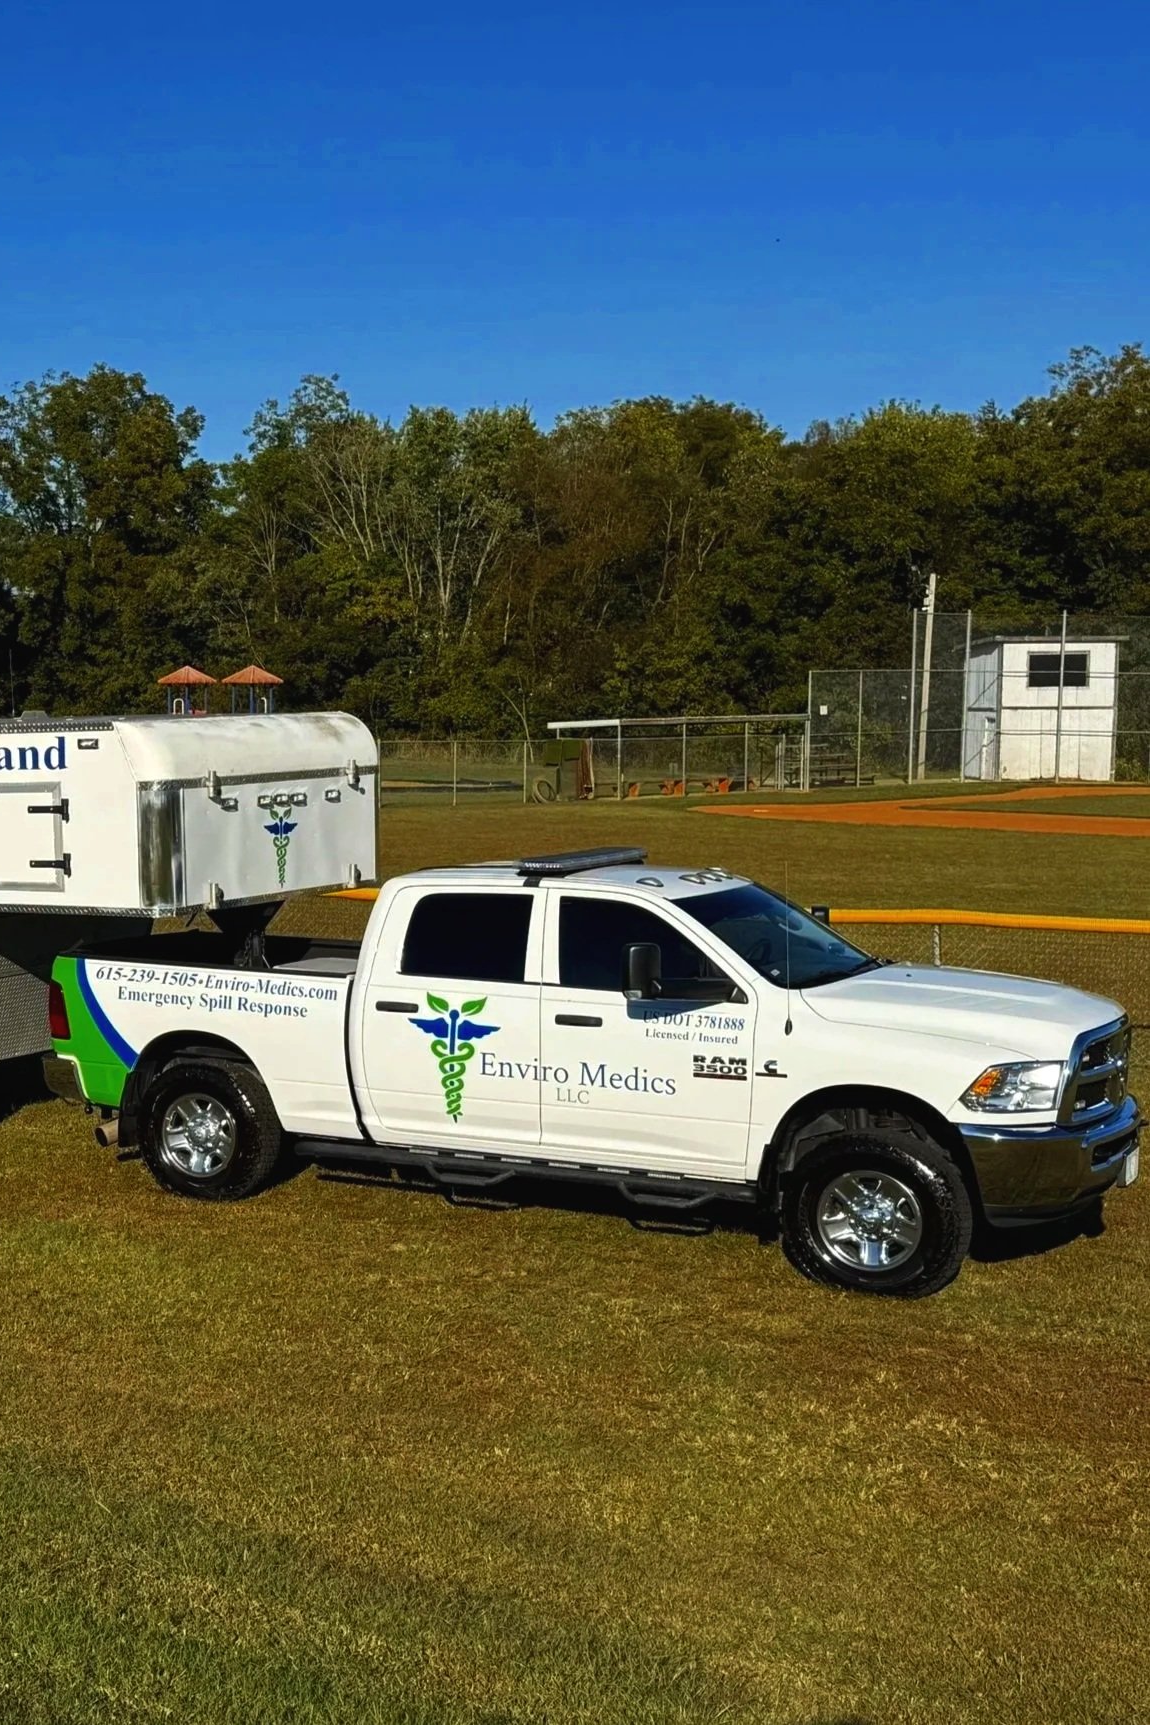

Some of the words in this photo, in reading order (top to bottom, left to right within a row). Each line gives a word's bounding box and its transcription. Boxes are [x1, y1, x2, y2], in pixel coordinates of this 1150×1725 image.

[117, 986, 195, 1010] Emergency
[199, 993, 232, 1012] Spill
[237, 996, 309, 1018] Response
[643, 1010, 660, 1024] US
[662, 1012, 694, 1027] DOT
[694, 1014, 746, 1031] 3781888
[645, 1028, 689, 1041] Licensed
[698, 1032, 738, 1045] Insured
[693, 1054, 748, 1067] RAM
[479, 1052, 569, 1084] Enviro
[578, 1061, 677, 1096] Medics
[693, 1063, 748, 1076] 3500
[556, 1087, 590, 1104] LLC
